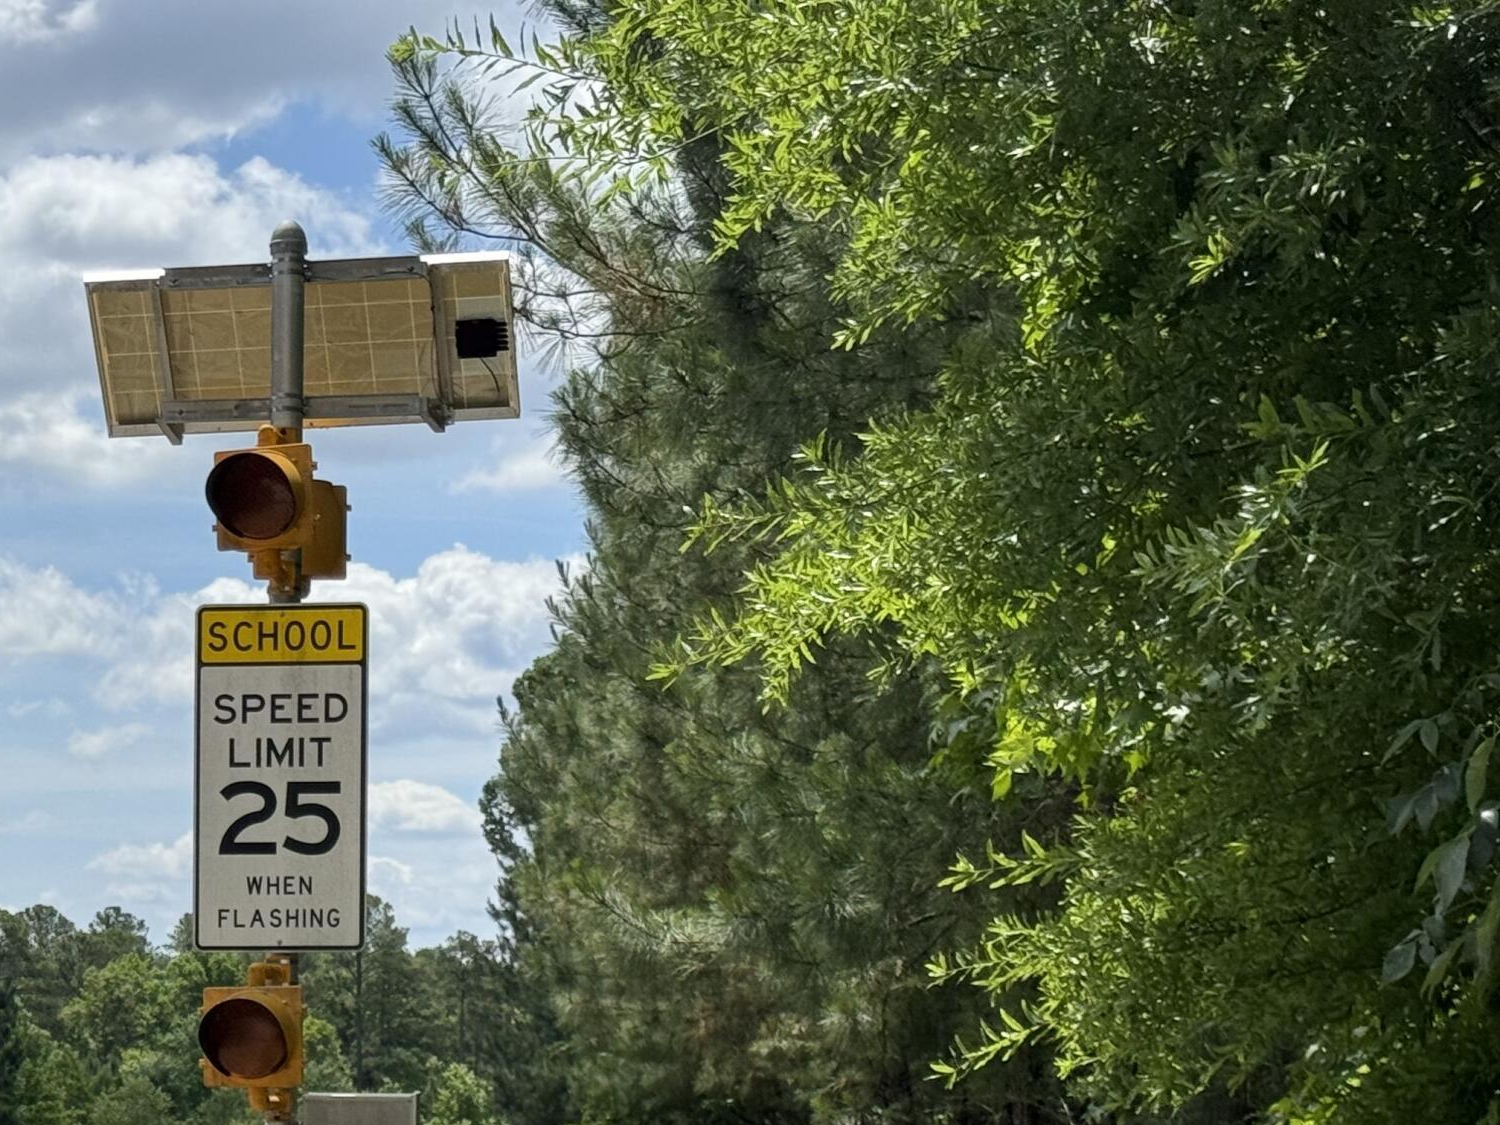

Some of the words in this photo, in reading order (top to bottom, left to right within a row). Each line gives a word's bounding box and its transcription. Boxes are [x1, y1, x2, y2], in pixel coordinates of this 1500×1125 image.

[208, 620, 356, 652] SCHOOL
[213, 693, 349, 724] SPEED
[229, 737, 332, 768] LIMIT
[218, 781, 341, 855] 25
[246, 876, 313, 895] WHEN
[218, 908, 341, 928] FLASHING
